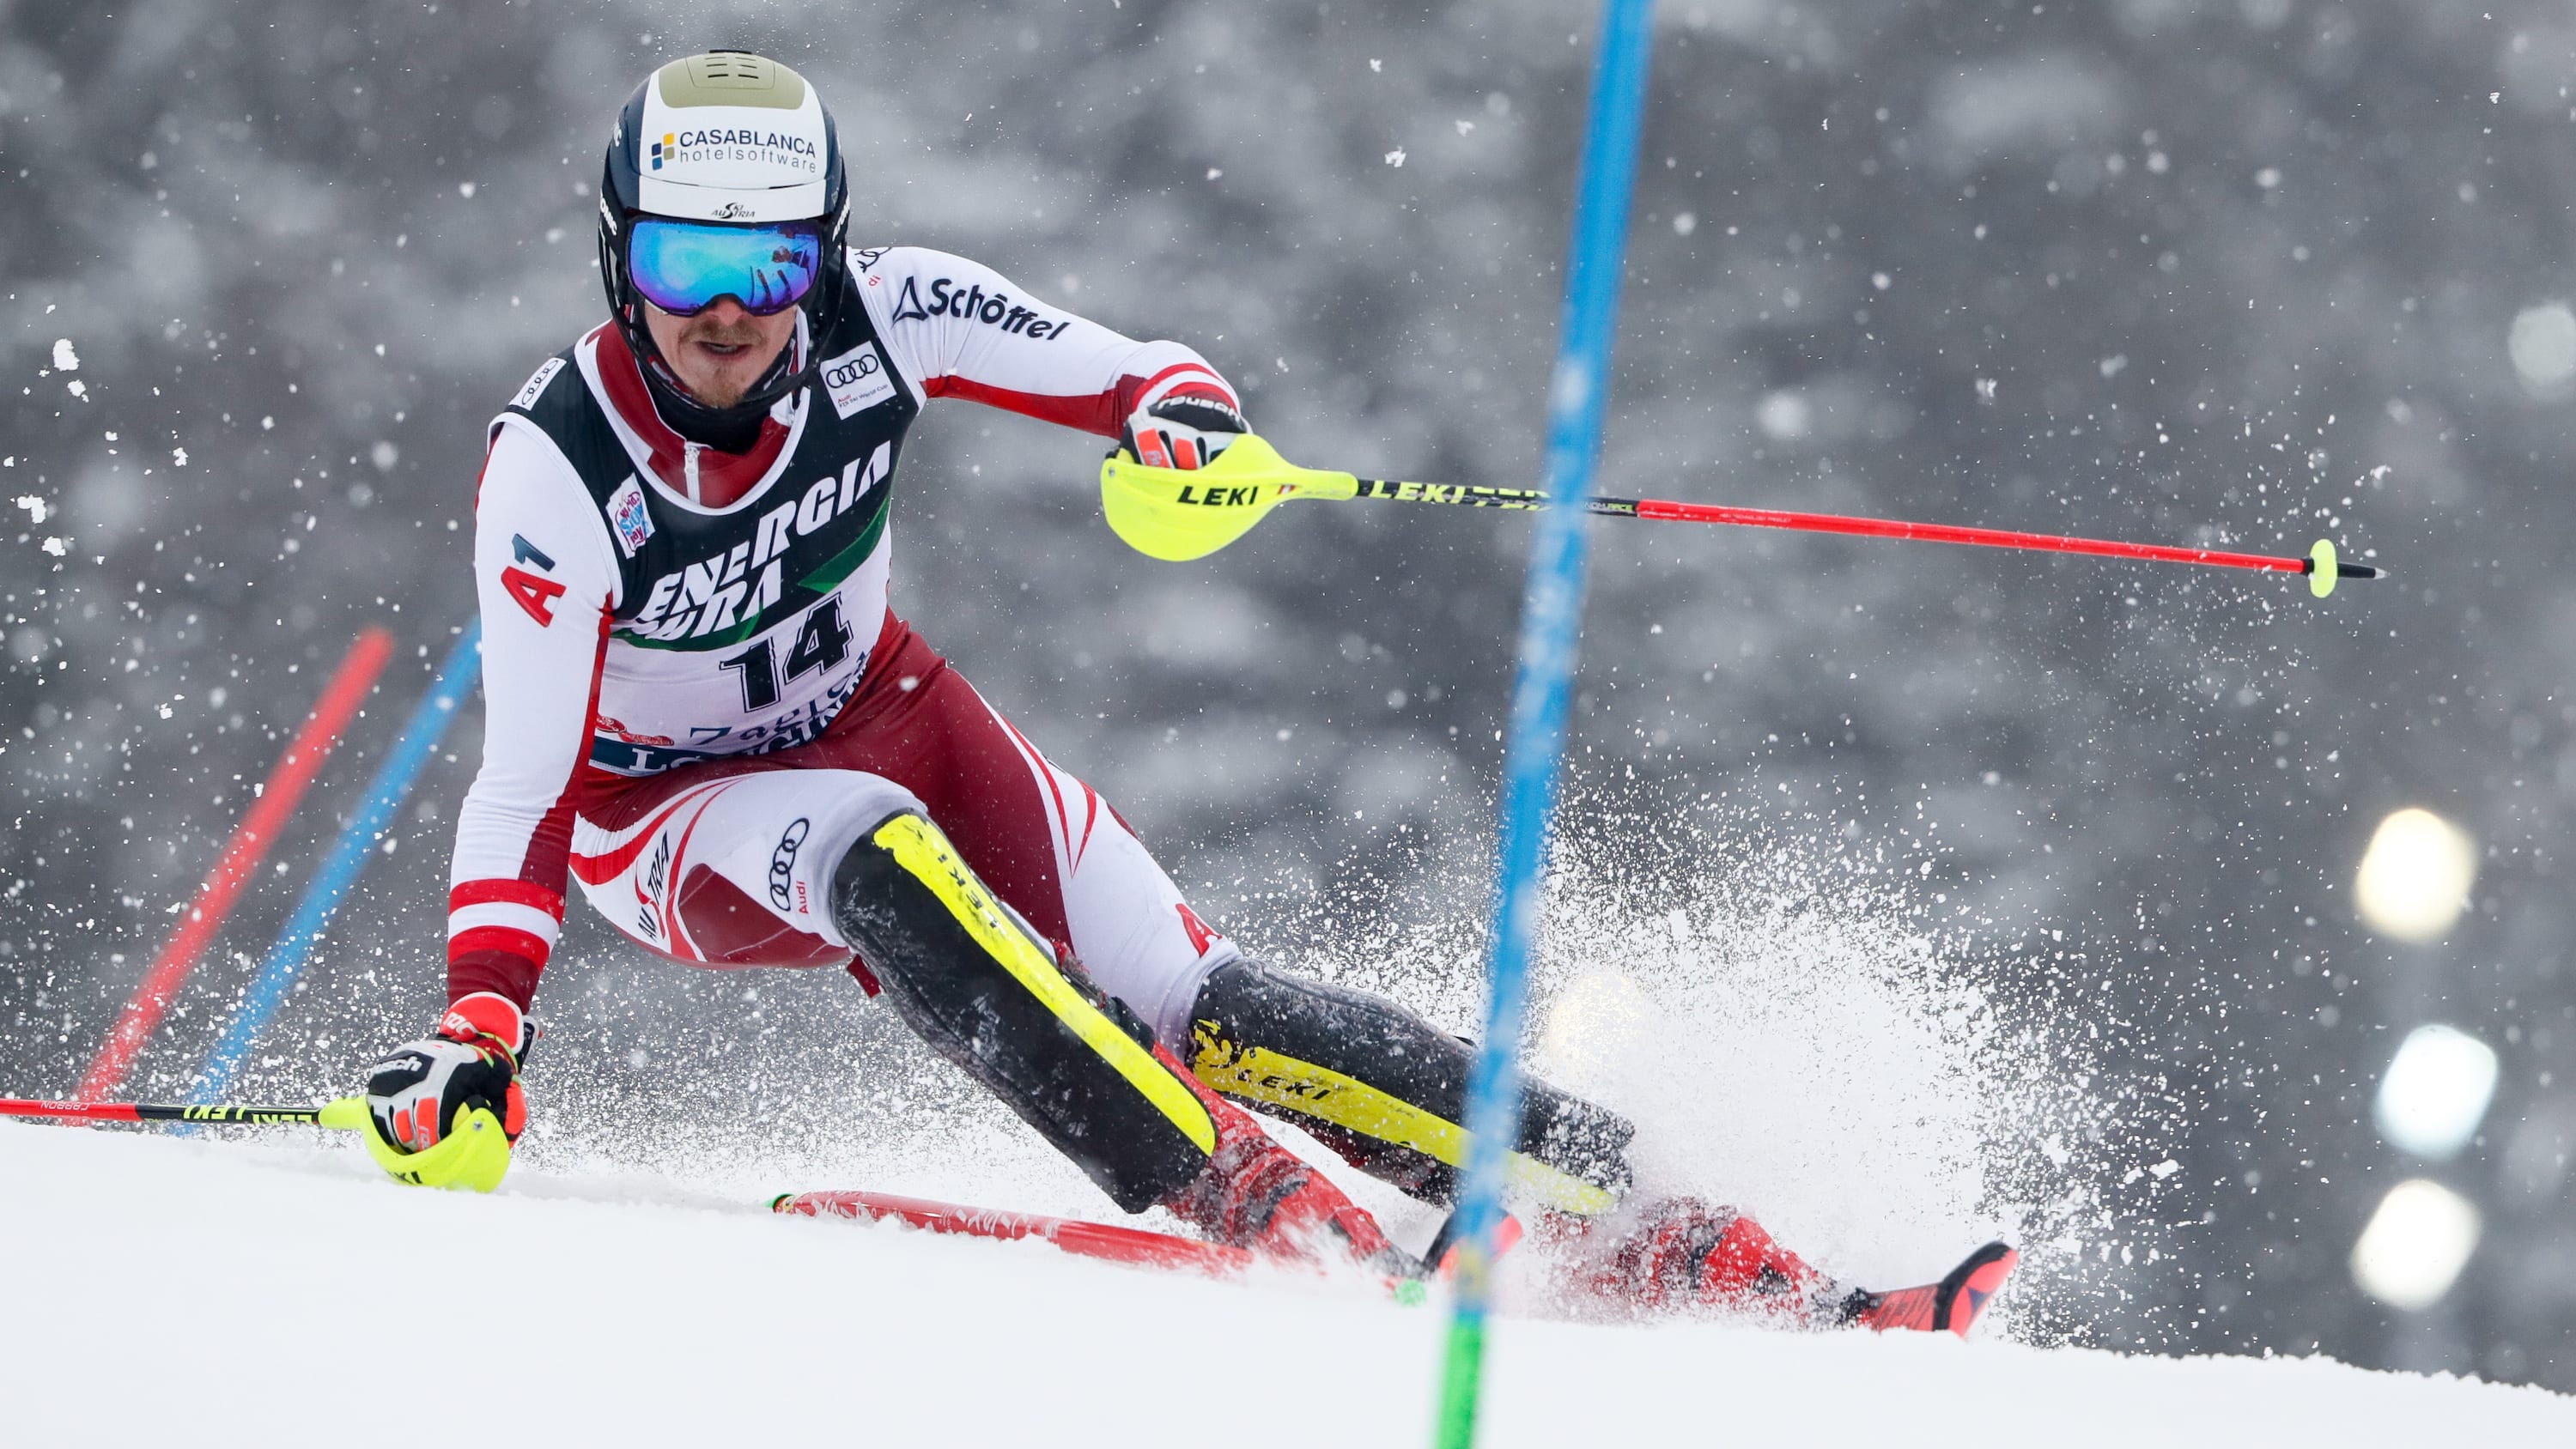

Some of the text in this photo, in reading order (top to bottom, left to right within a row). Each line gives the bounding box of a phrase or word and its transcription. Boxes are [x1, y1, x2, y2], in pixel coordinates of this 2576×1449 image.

[680, 129, 816, 158] CASABLANCA
[680, 146, 816, 173] hotelsoftware
[927, 278, 1071, 340] Schöffel
[1177, 485, 1259, 506] LEKI
[1367, 479, 1467, 504] LEKI
[637, 440, 890, 621] ENERGIA
[501, 532, 567, 628] A1
[718, 591, 855, 714] 14
[795, 879, 810, 915] Audi
[40, 1101, 90, 1111] CARBON
